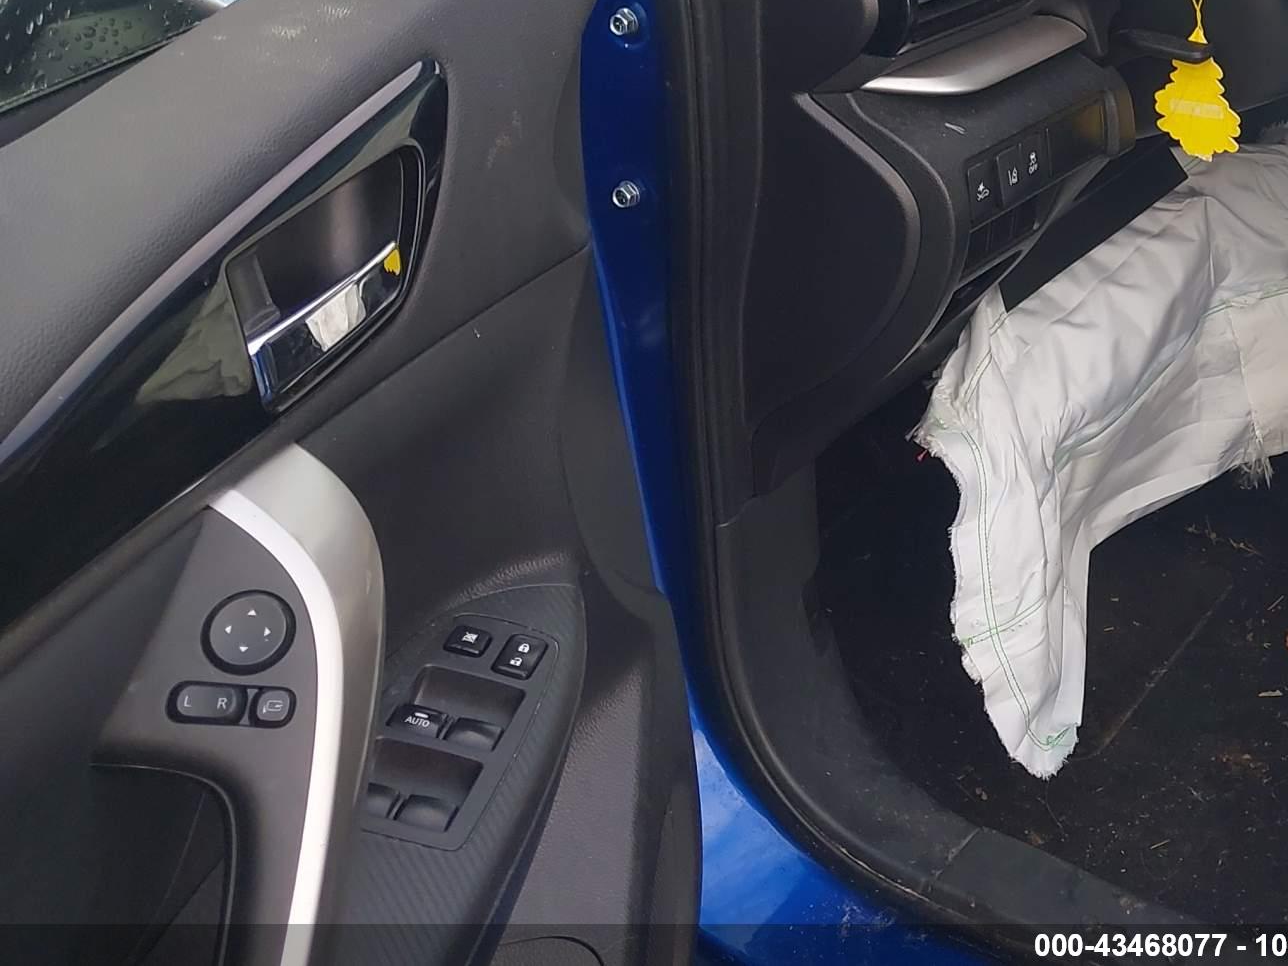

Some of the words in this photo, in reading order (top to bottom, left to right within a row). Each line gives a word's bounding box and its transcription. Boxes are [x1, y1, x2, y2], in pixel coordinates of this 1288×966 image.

[183, 695, 193, 709] L
[216, 697, 228, 710] R
[404, 715, 431, 728] AUTO
